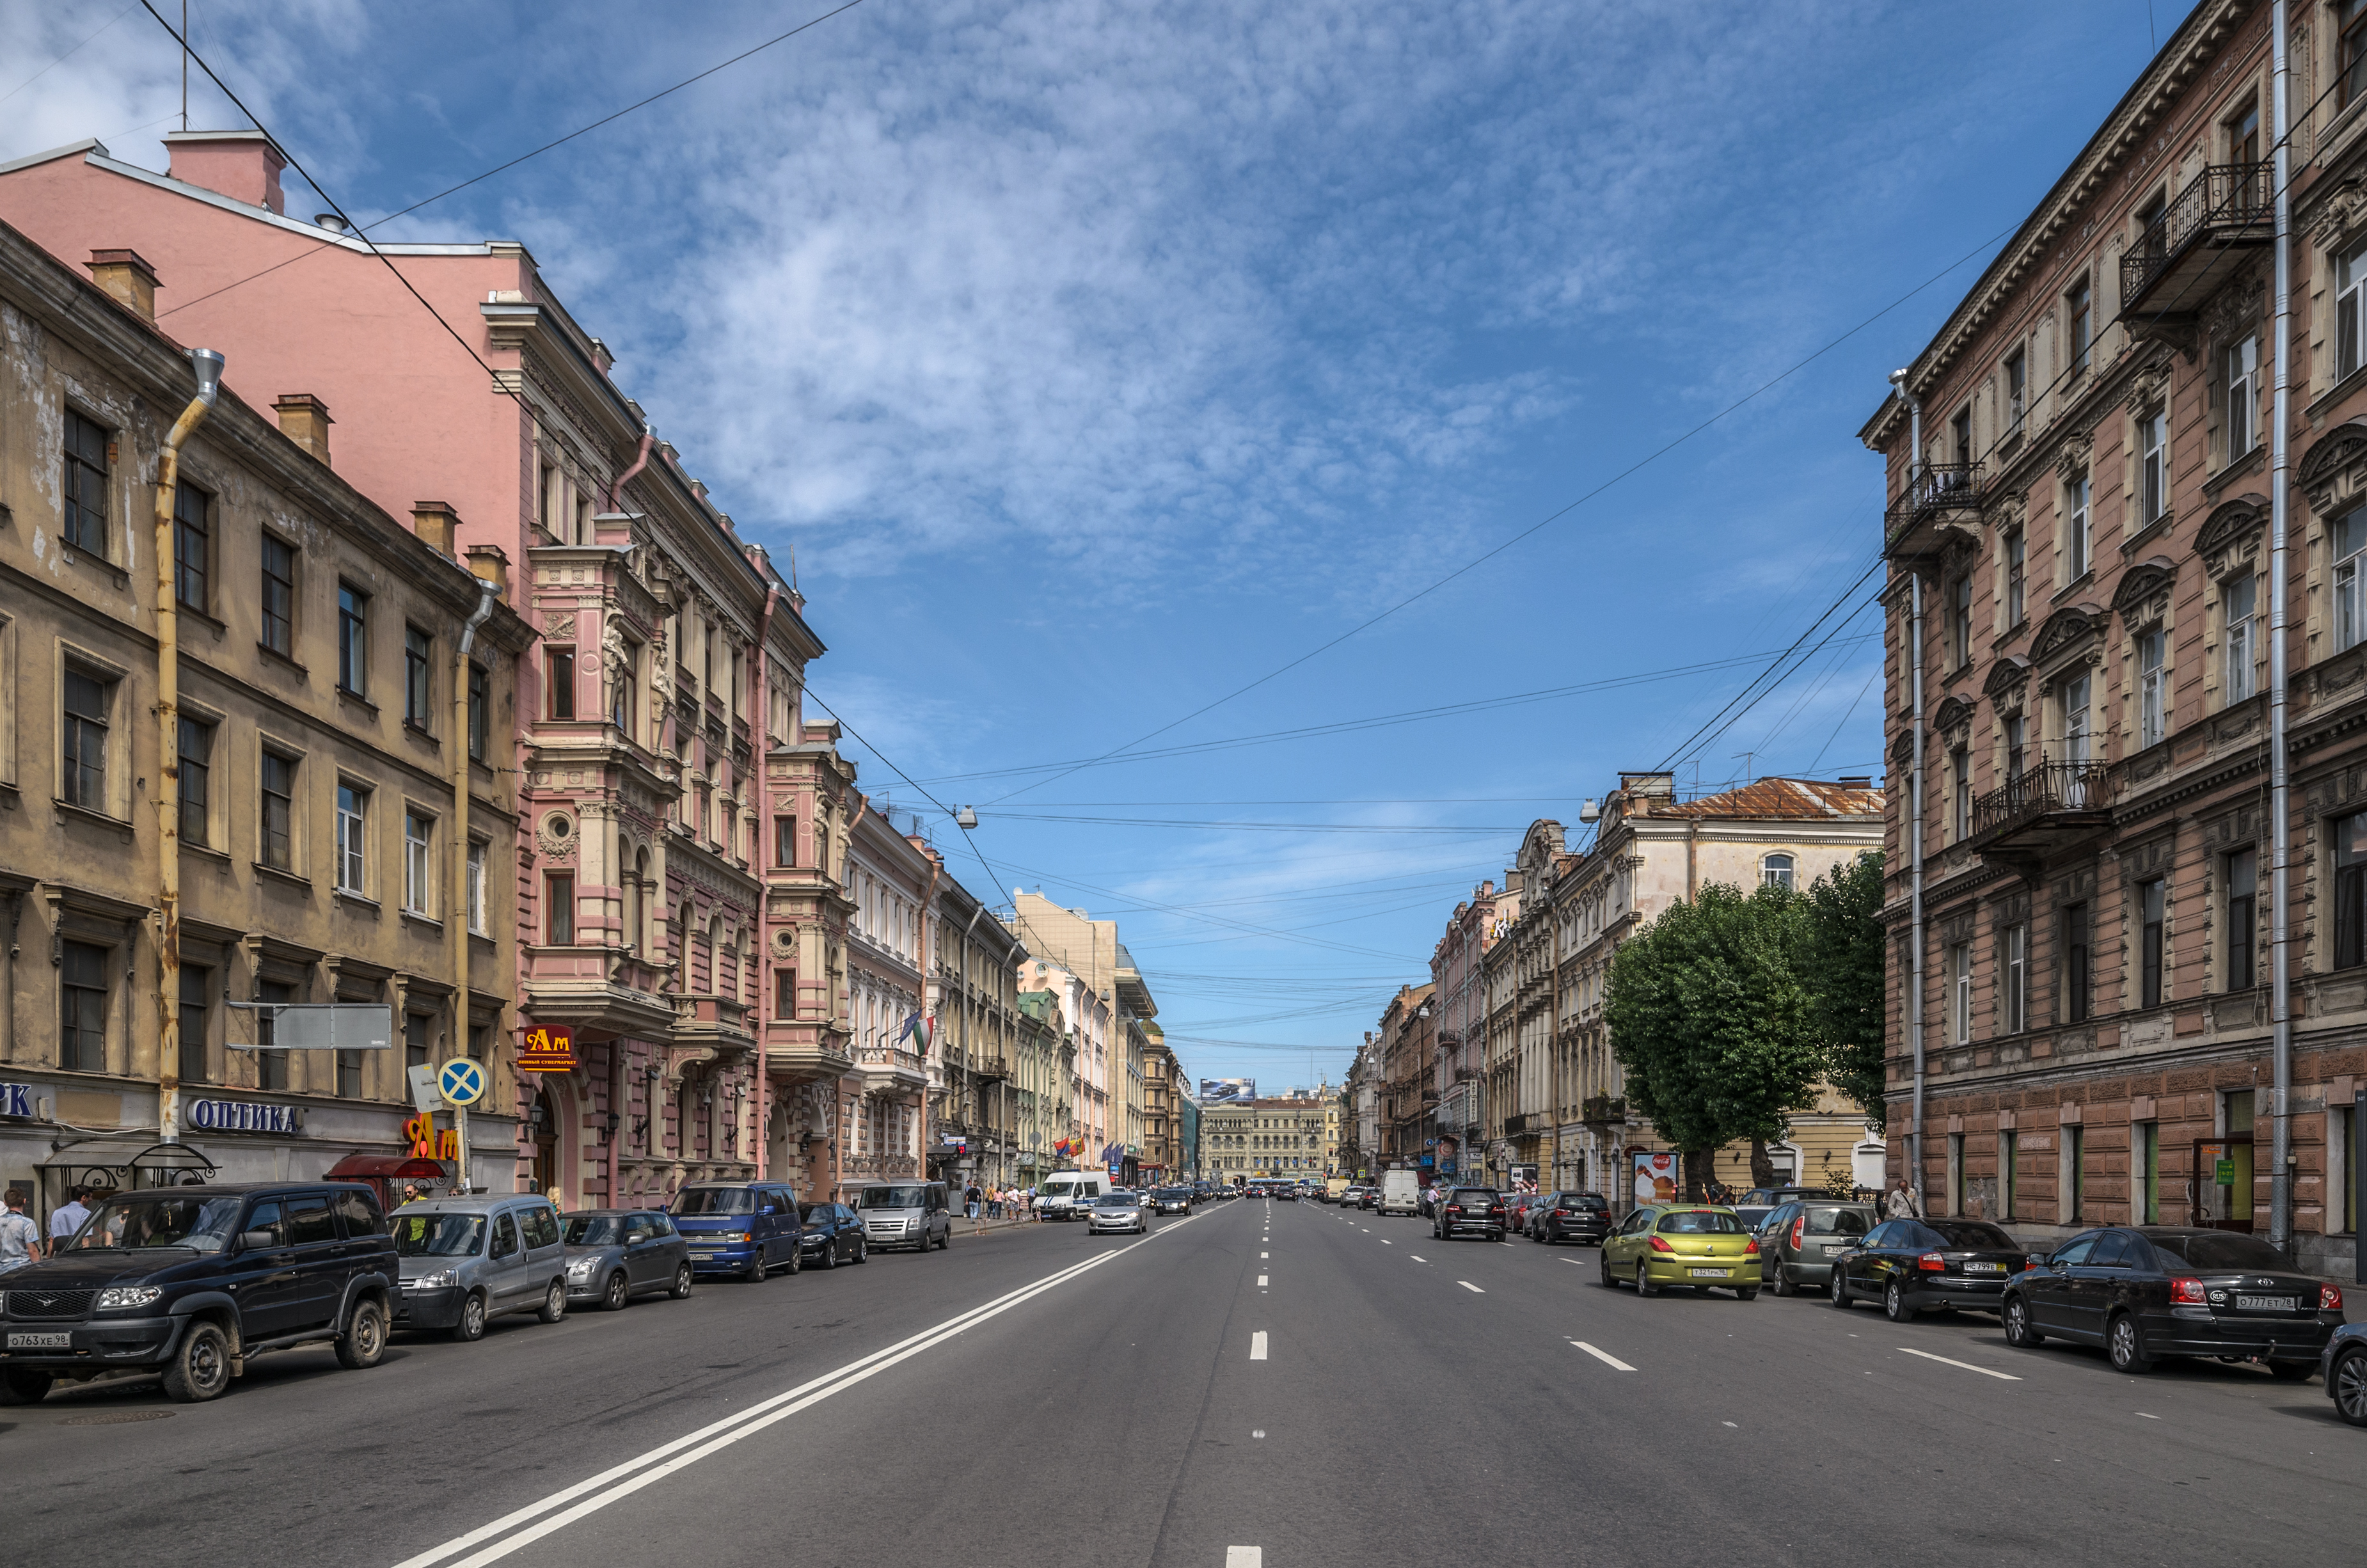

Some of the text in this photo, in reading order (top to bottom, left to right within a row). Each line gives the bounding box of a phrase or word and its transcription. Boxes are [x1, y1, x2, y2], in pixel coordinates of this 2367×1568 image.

[527, 1029, 570, 1051] Ам
[196, 1100, 297, 1132] ОПТИКА
[55, 1334, 66, 1343] 98
